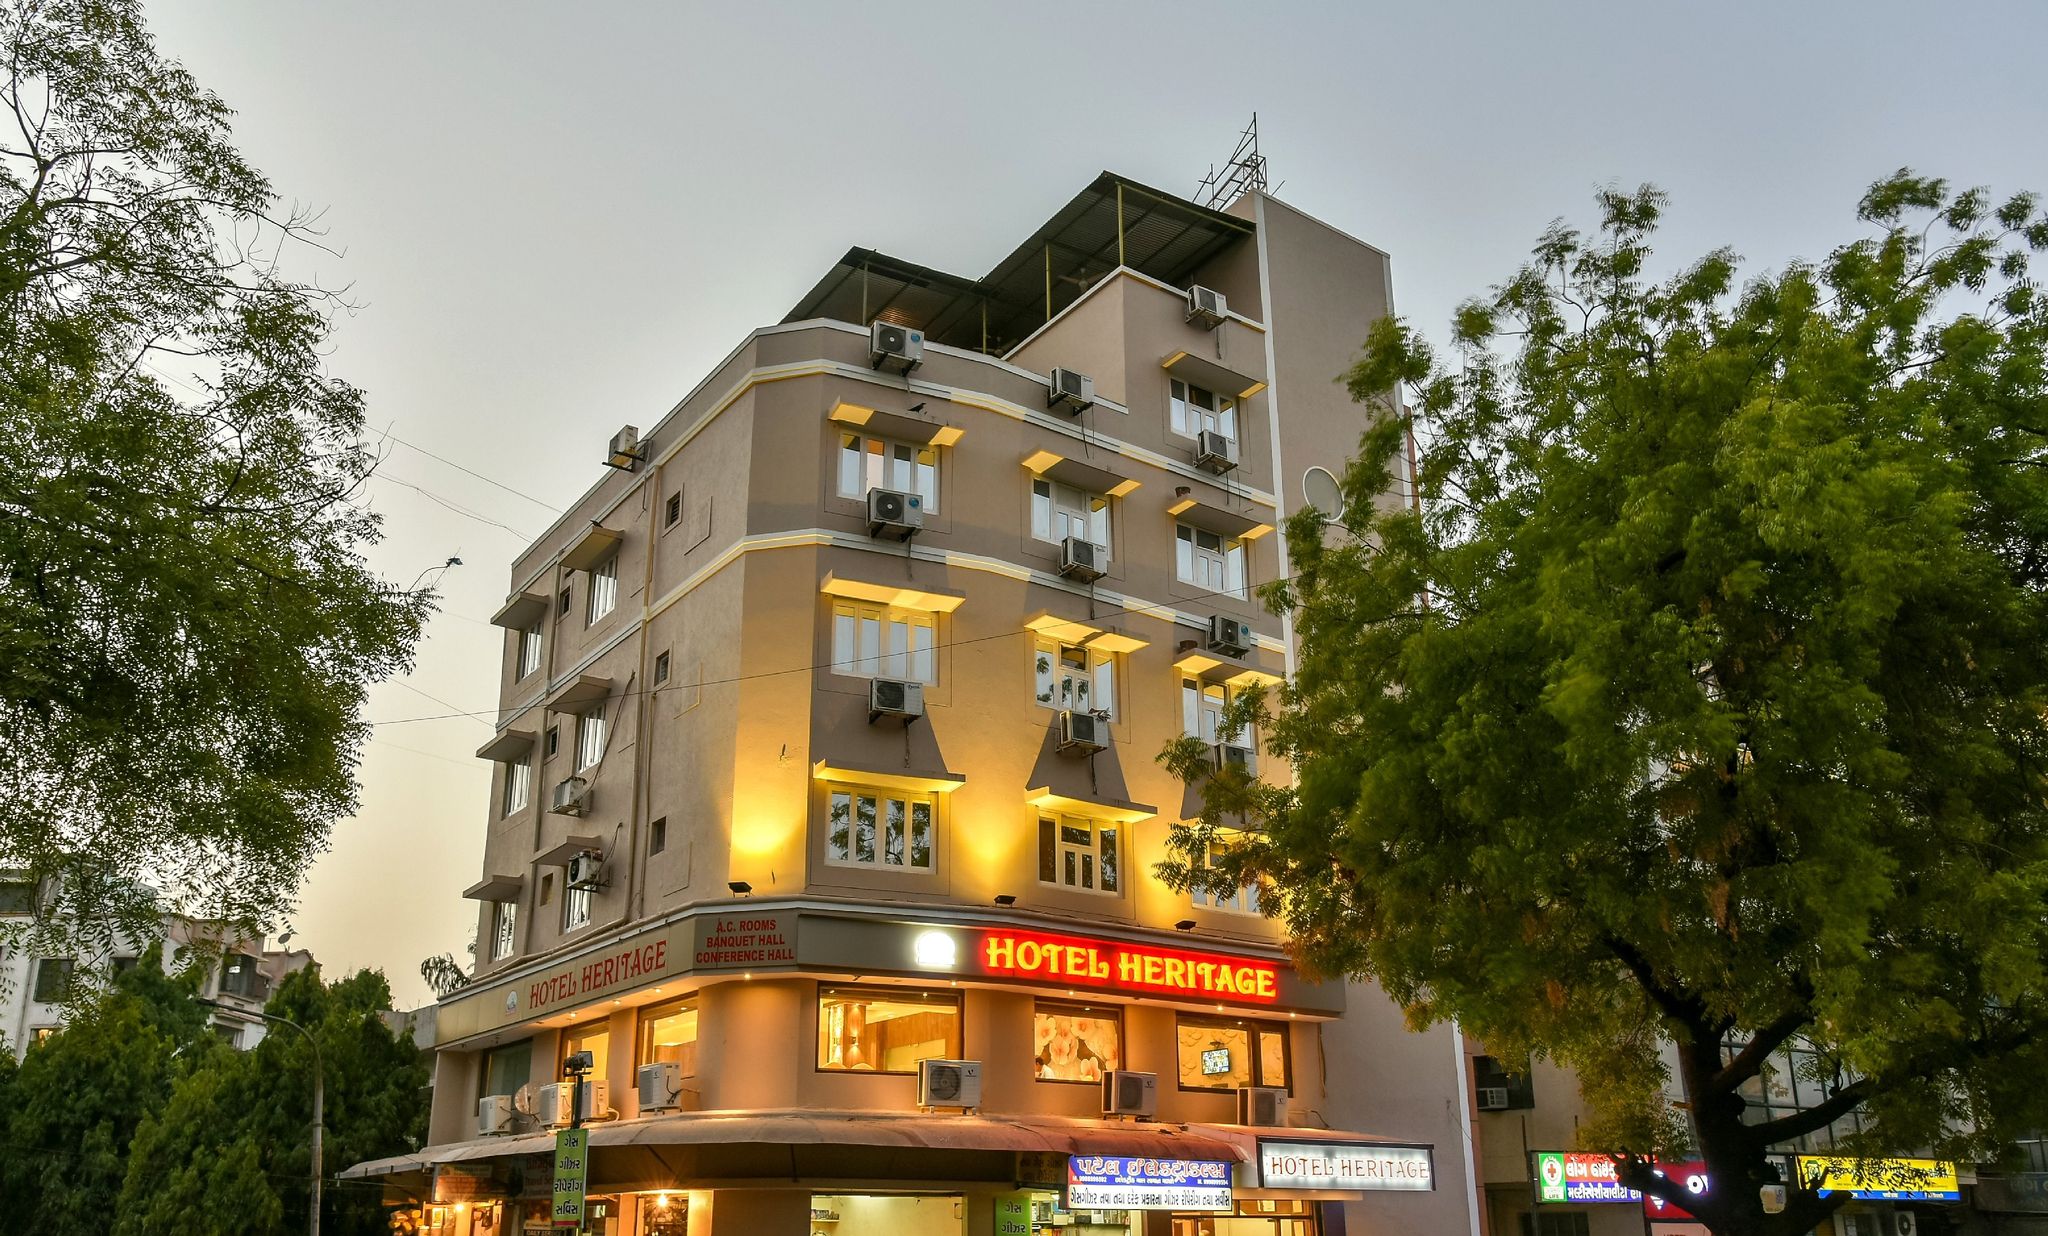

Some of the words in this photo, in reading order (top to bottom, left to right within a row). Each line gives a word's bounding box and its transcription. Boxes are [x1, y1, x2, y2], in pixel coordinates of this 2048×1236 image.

[716, 921, 736, 933] A.C.
[740, 919, 776, 932] ROOMS
[706, 935, 756, 948] BANQUET
[758, 934, 785, 946] HALL
[696, 950, 765, 963] CONFERENCE
[767, 949, 795, 961] HALL
[986, 937, 1110, 979] HOTEL
[1118, 952, 1277, 997] HERITAGE
[529, 971, 576, 1010] HOTEL
[581, 940, 667, 993] HERITAGE
[564, 1133, 579, 1148] ગેસ
[559, 1156, 581, 1170] ગીઝર
[1271, 1156, 1334, 1176] HOTEL
[1341, 1159, 1430, 1179] HERITAGE
[1004, 1200, 1022, 1214] ગેસ
